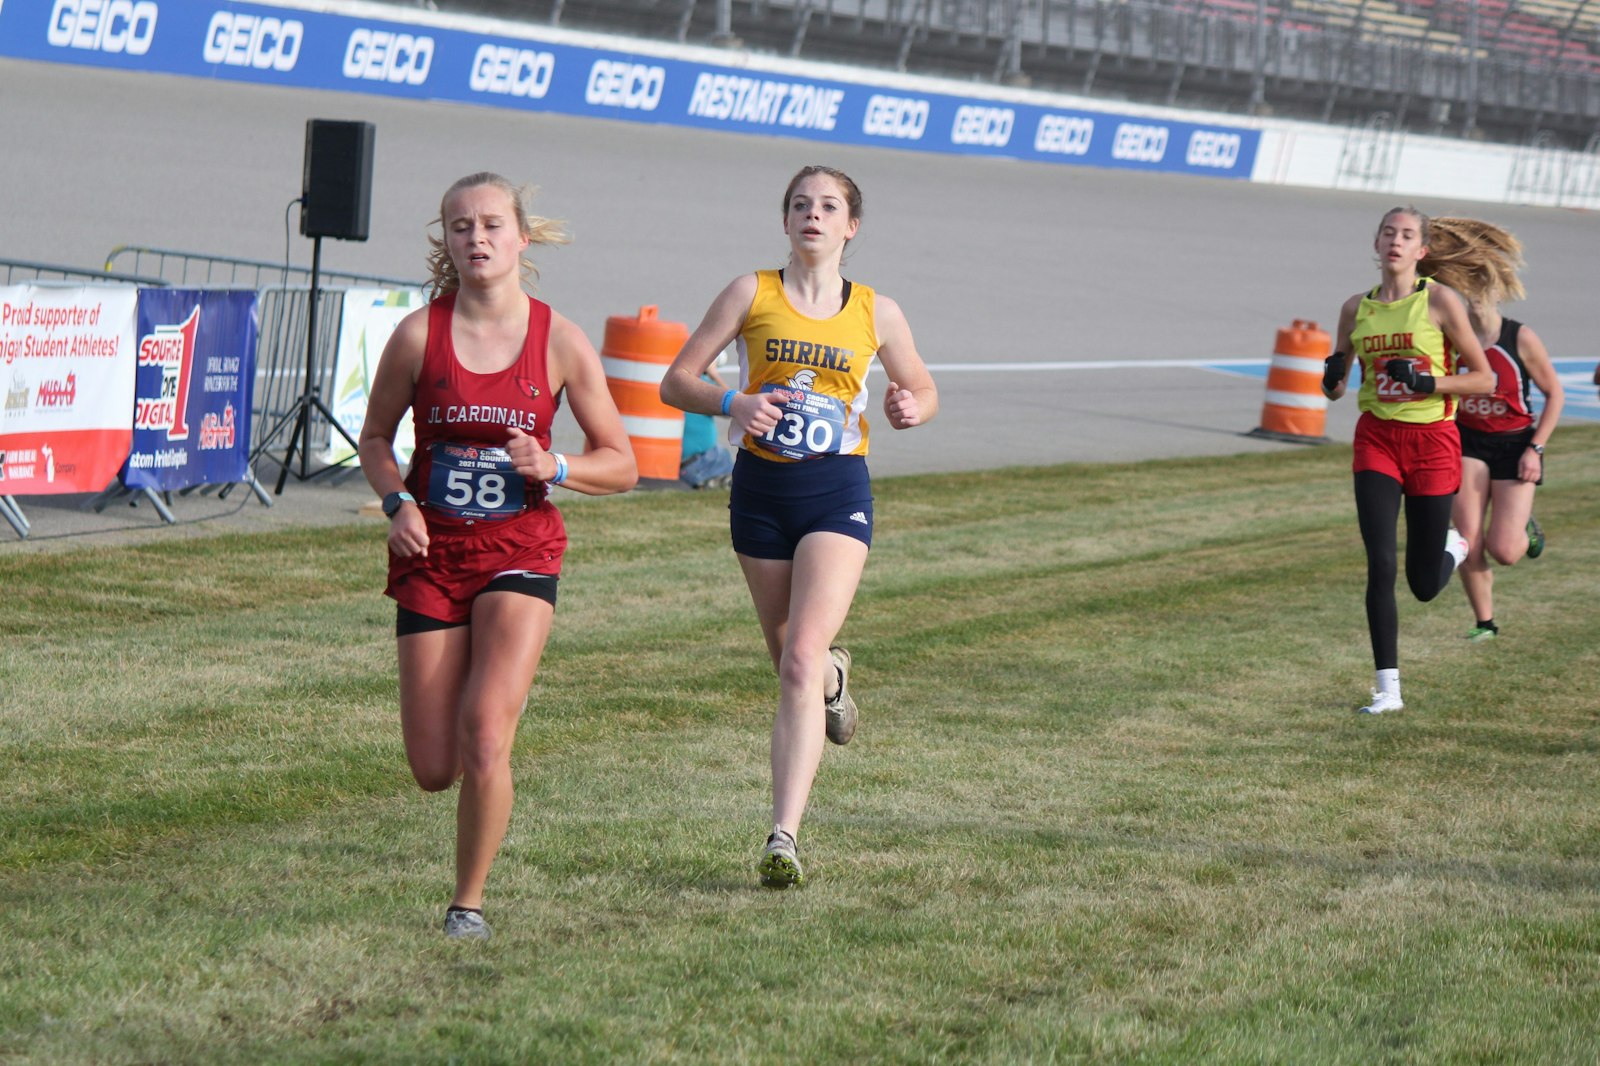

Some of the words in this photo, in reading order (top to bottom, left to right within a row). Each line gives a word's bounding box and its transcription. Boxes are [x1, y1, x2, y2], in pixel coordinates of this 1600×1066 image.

[47, 0, 157, 55] GEICO
[203, 10, 303, 72] GEICO
[343, 28, 435, 86] GEICO
[469, 44, 555, 99] GEICO
[585, 59, 665, 111] GEICO
[688, 73, 788, 125] RESTART
[779, 82, 845, 132] ZONE
[862, 94, 930, 140] GEICO
[950, 105, 1015, 148] GEICO
[1034, 114, 1094, 156] GEICO
[1111, 122, 1169, 163] GEICO
[1185, 130, 1241, 169] GEICO
[34, 305, 88, 331] supporter
[89, 302, 102, 326] of
[24, 333, 68, 357] Student
[70, 333, 120, 358] Athletes!
[139, 338, 181, 362] SOURCE
[766, 339, 853, 373] SHRINE
[1363, 333, 1414, 353] COLON
[428, 406, 442, 424] JL
[446, 405, 536, 431] CARDINALS
[786, 402, 801, 410] 2021
[802, 405, 820, 415] FINAL
[805, 399, 836, 411] COUNTRY
[806, 394, 829, 404] CROSS
[477, 461, 497, 470] FINAL
[445, 469, 506, 509] 58
